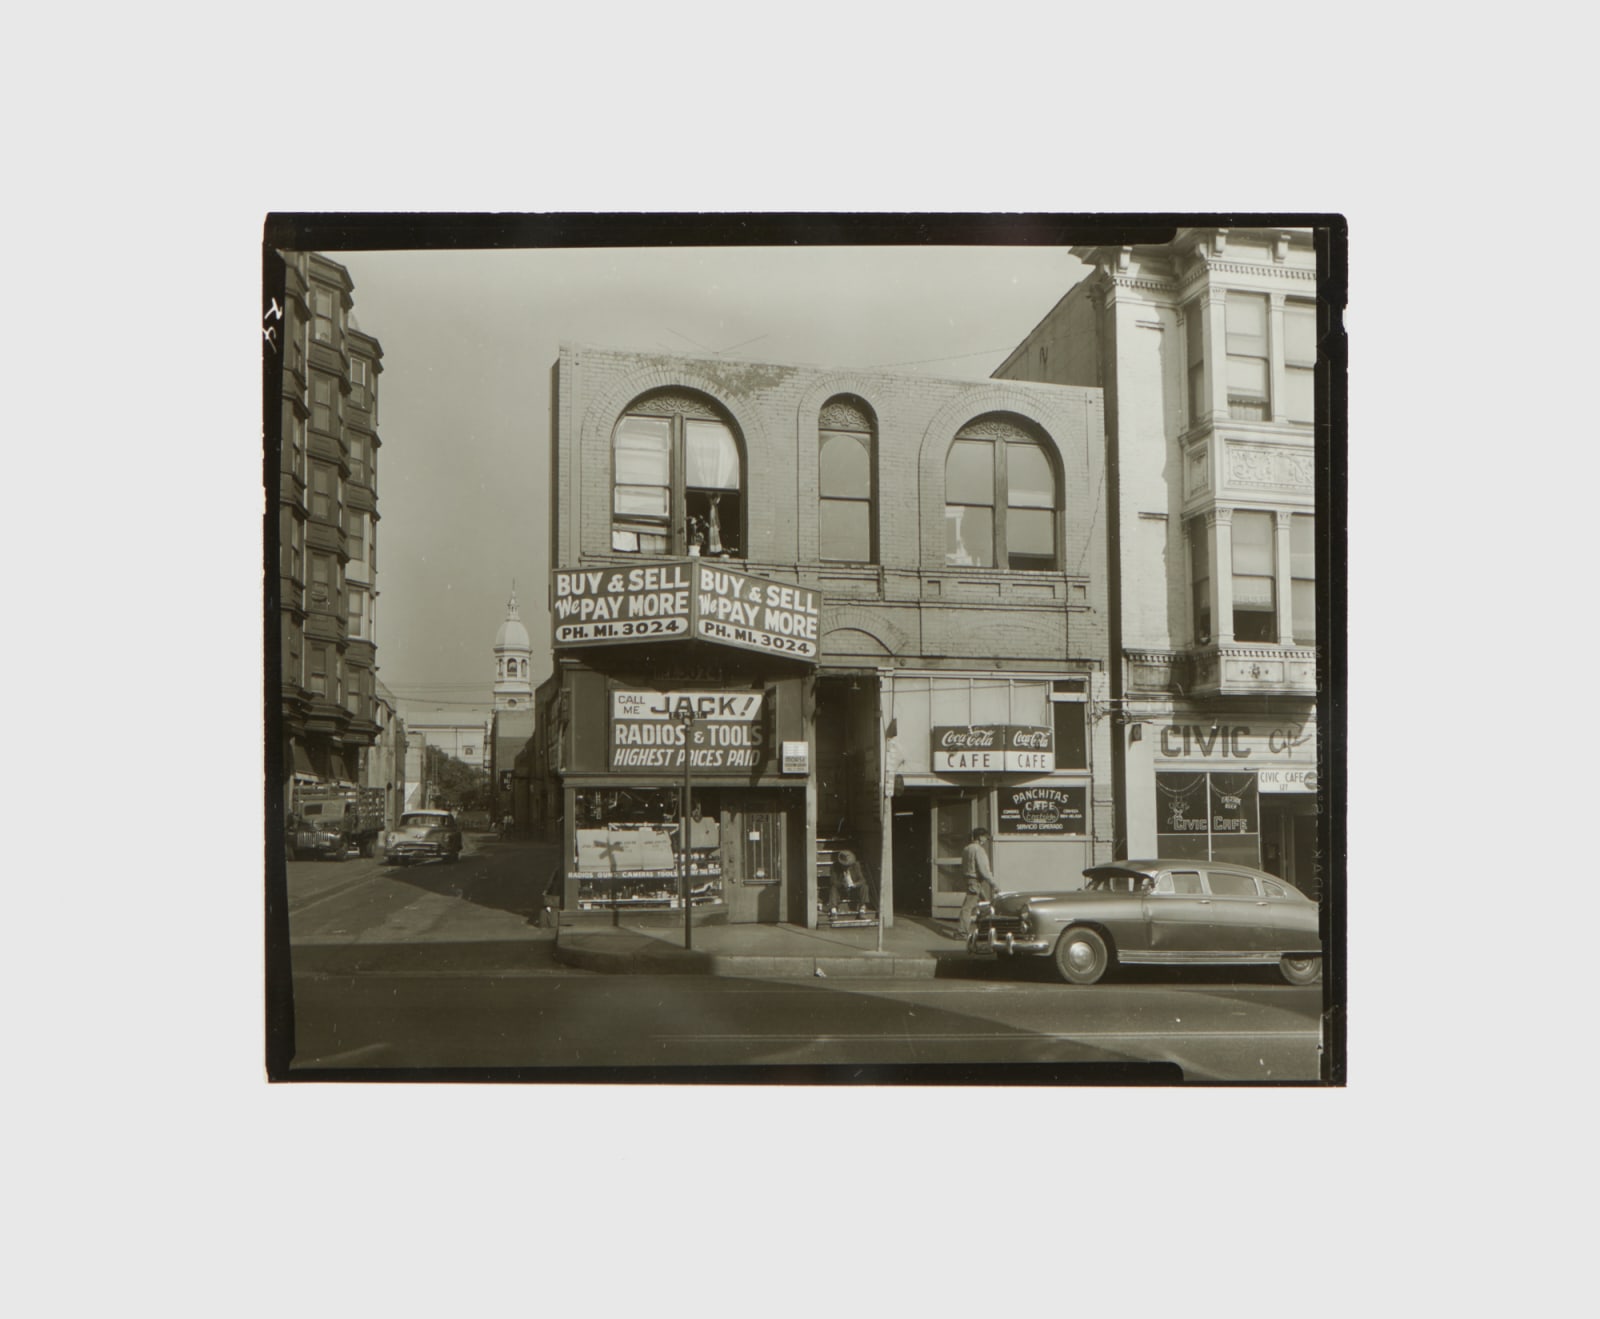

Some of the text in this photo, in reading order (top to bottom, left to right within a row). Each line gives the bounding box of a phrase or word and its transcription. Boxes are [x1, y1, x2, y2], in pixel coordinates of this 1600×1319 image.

[557, 566, 690, 596] BUY & SELL
[700, 569, 818, 615] BUY & SELL
[555, 591, 689, 621] We PAY MORE
[699, 595, 817, 640] We PAY MORE
[562, 620, 679, 640] PH. MI. 3024
[704, 622, 810, 655] PH. MI. 3024
[618, 695, 646, 705] CALL
[650, 696, 754, 716] JACK!
[623, 706, 640, 715] ME
[615, 723, 763, 747] RADIOS & TOOLS
[1160, 724, 1252, 758] CIVIC
[614, 748, 674, 766] HIGHEST
[726, 749, 761, 767] PAID
[947, 753, 991, 768] CAFE
[1017, 753, 1046, 769] CAFE
[1260, 772, 1280, 783] CIVIC
[1285, 772, 1304, 783] CAFE
[1012, 788, 1070, 805] PANCHITAS
[1025, 800, 1056, 811] CAFE
[622, 870, 654, 879] CAMERAS
[657, 870, 679, 879] TOOLS
